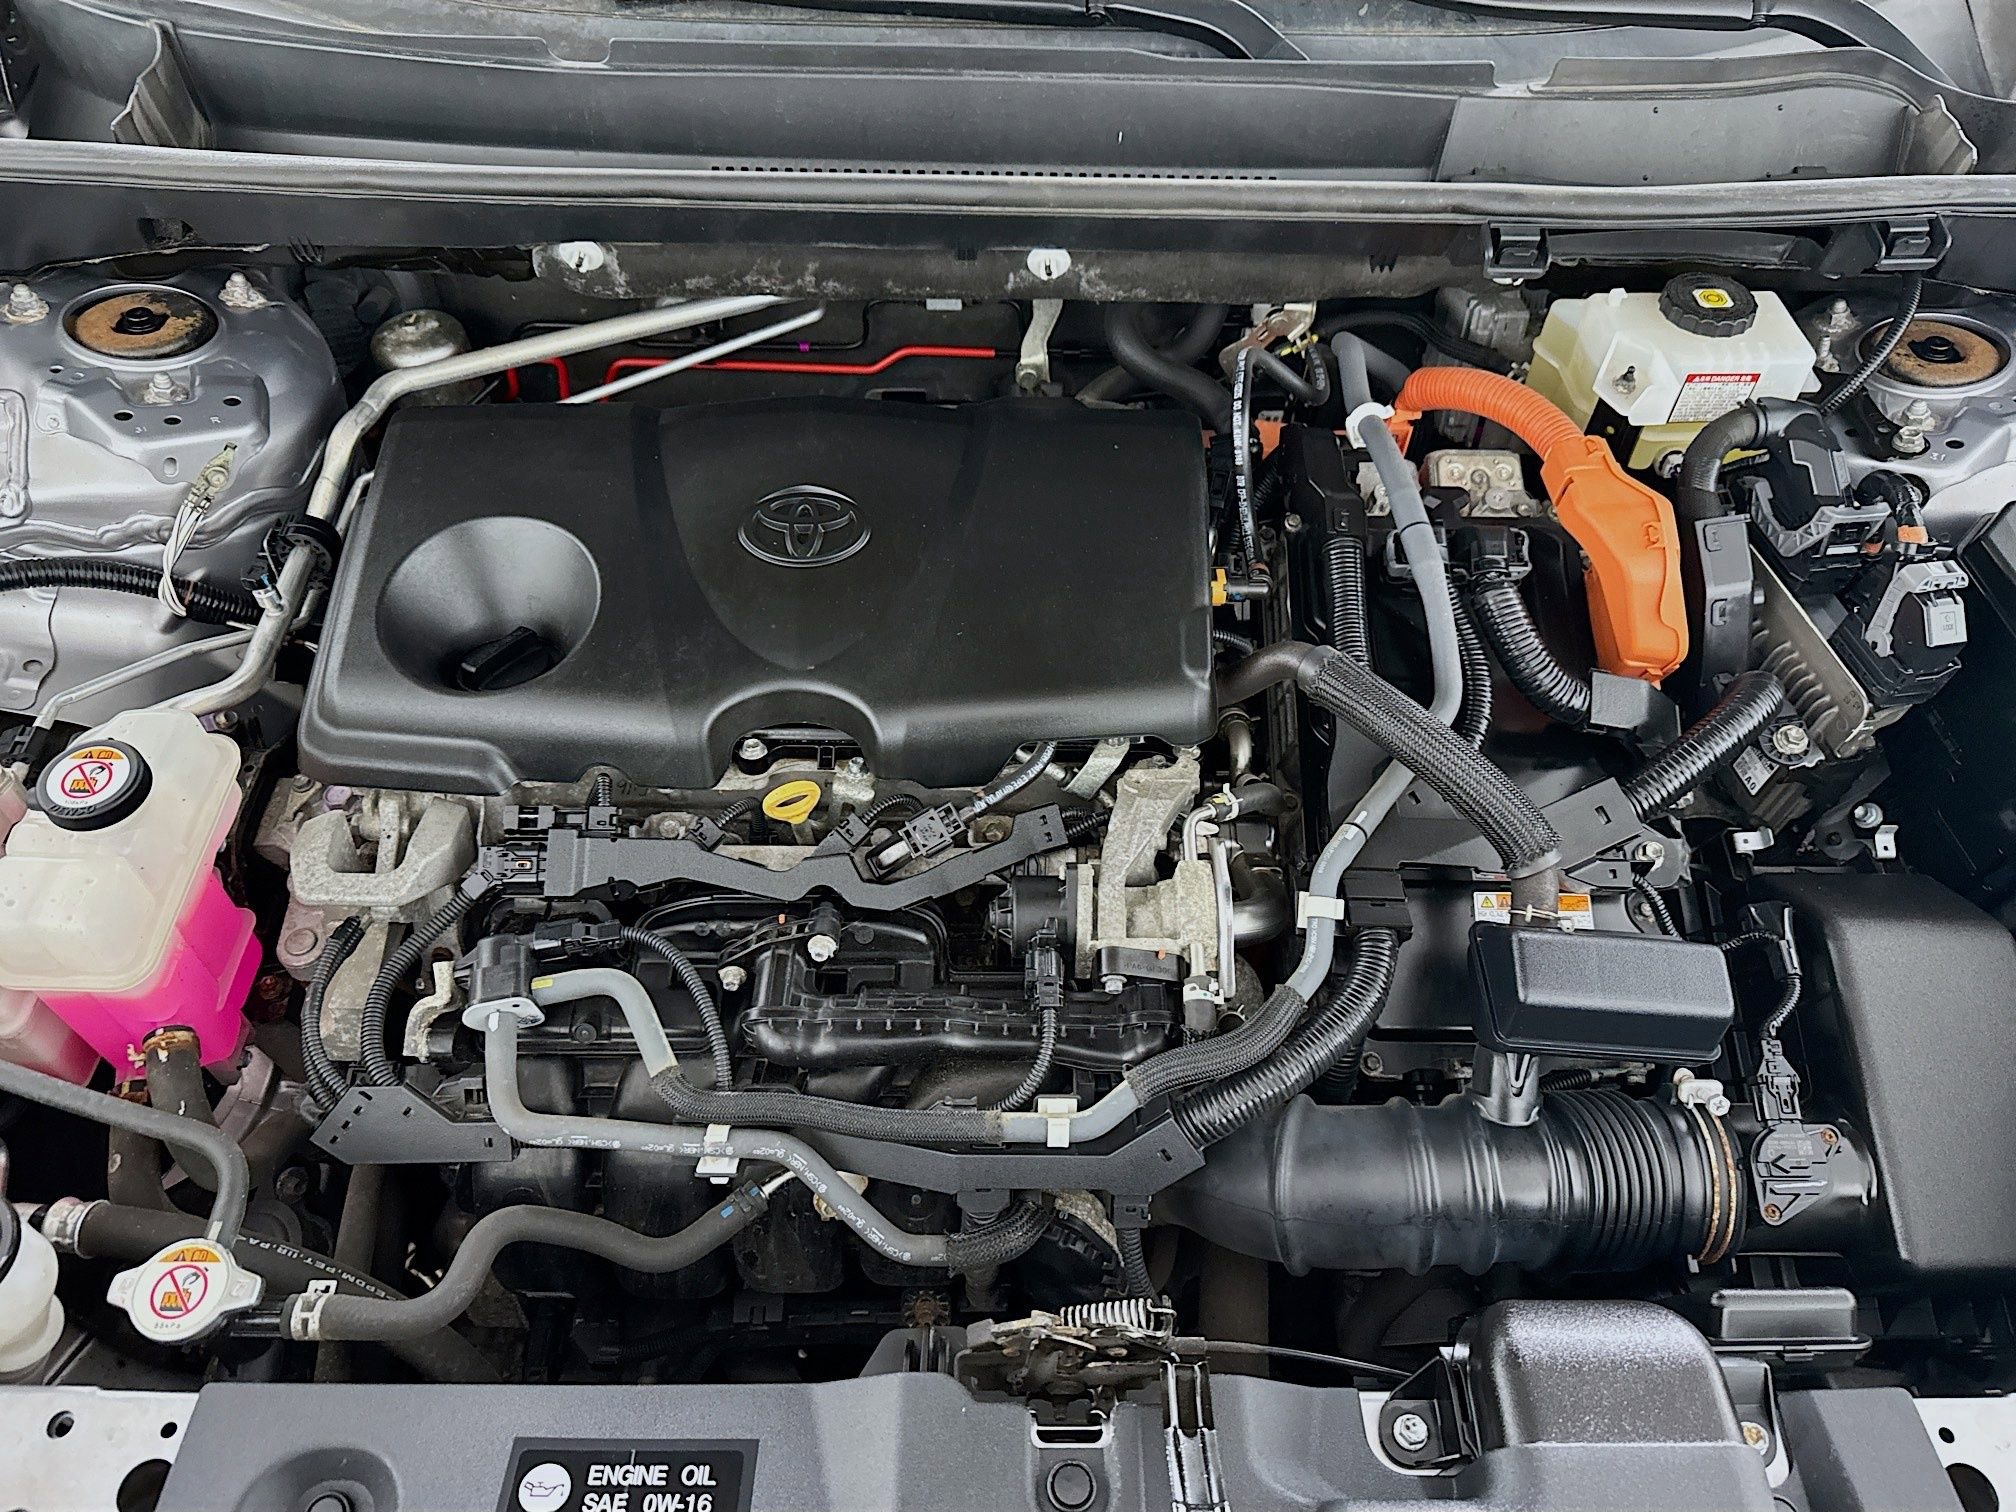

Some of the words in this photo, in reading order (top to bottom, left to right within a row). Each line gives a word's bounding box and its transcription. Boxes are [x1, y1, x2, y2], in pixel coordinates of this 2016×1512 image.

[587, 1465, 669, 1486] ENGINE
[681, 1465, 717, 1486] OIL
[582, 1493, 629, 1512] SAE
[643, 1493, 712, 1512] 0W-16
